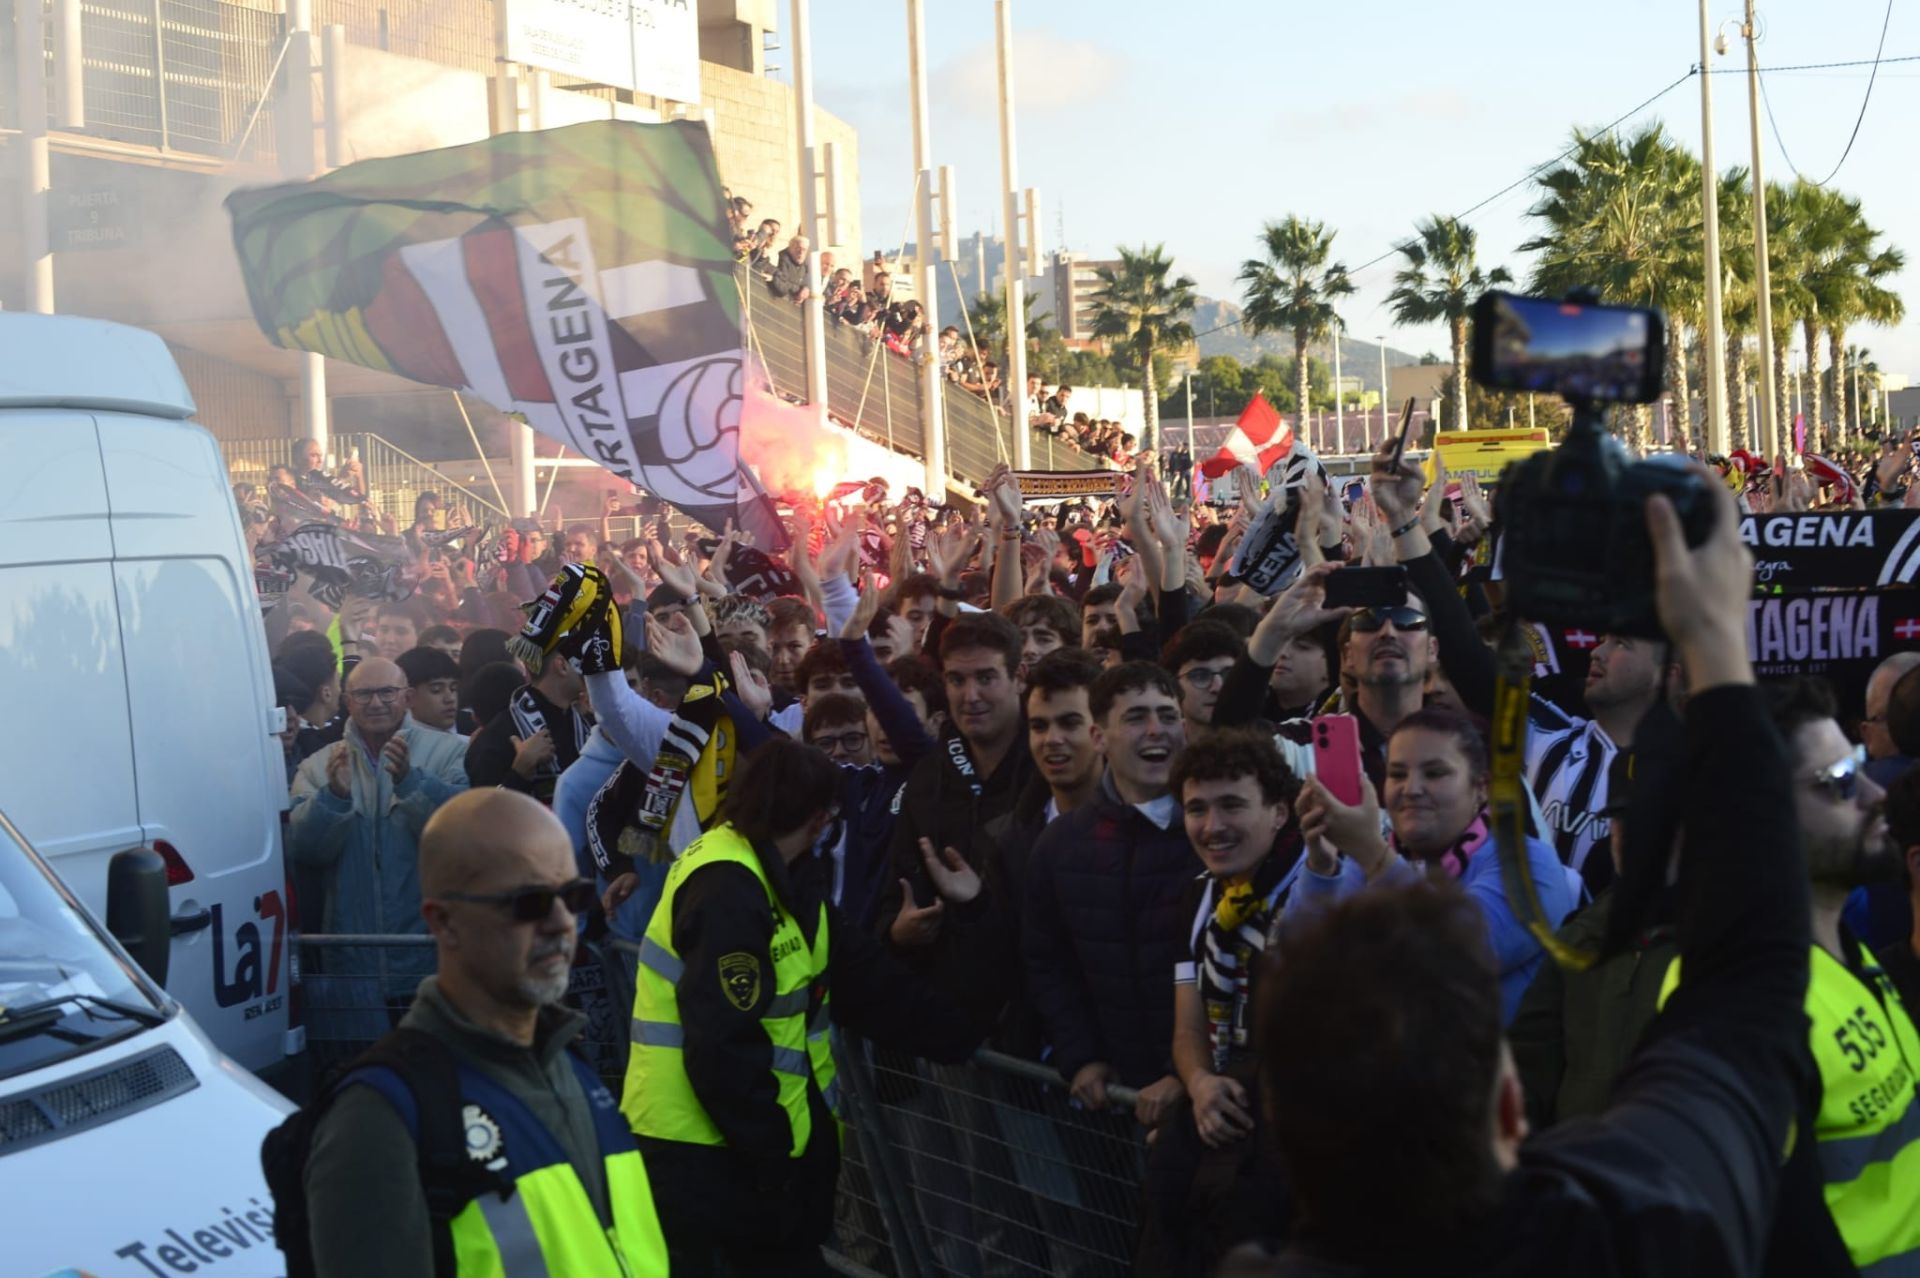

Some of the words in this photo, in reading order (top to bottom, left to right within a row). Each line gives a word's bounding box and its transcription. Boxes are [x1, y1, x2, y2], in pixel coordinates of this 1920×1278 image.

[538, 233, 636, 479] RTAGENA
[1443, 466, 1498, 480] AMBUL
[1738, 515, 1875, 547] AGENA
[1754, 560, 1793, 581] egra
[1747, 595, 1879, 661] TAGENA
[210, 889, 285, 1009] La7
[1833, 1006, 1886, 1072] 535
